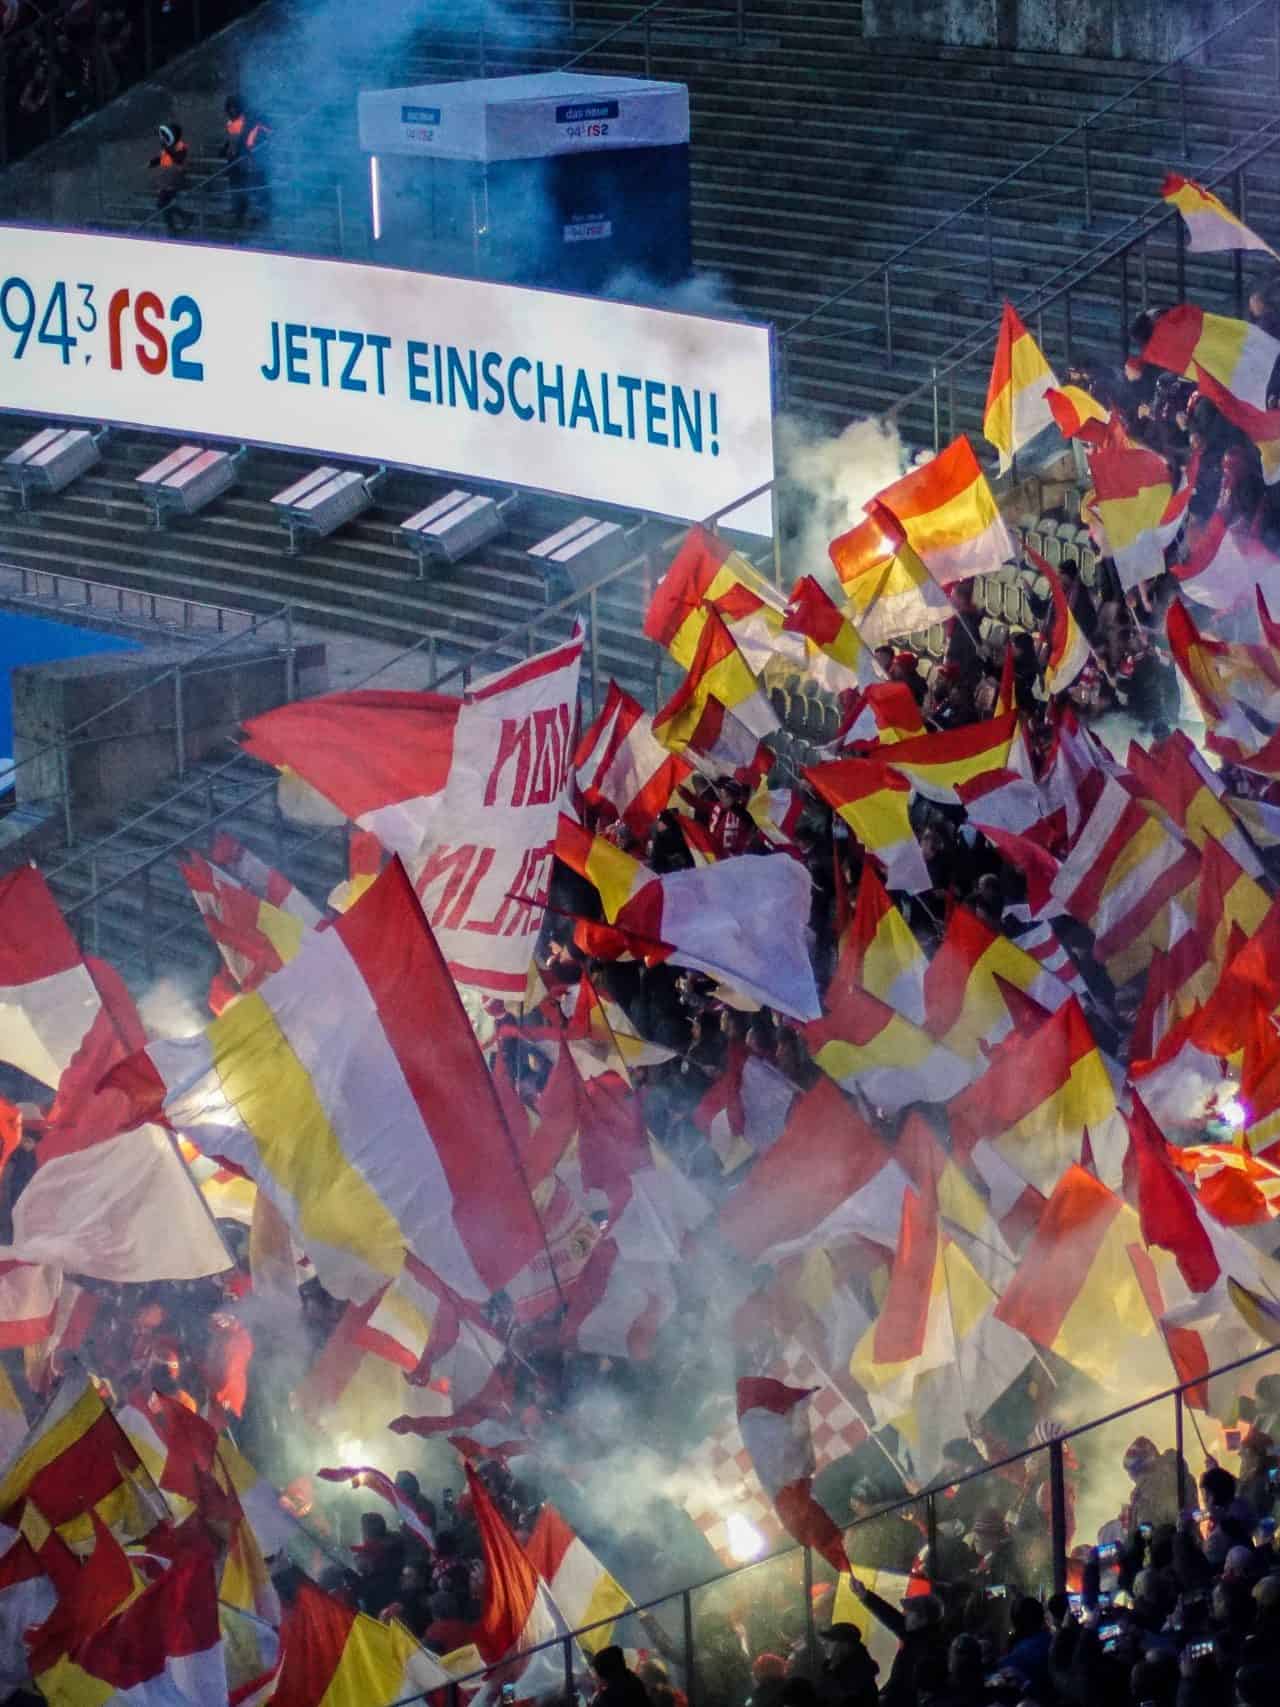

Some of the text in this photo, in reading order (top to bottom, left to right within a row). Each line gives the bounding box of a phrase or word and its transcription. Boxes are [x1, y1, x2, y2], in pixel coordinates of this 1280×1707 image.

[107, 288, 204, 381] rs2
[260, 321, 391, 395] JETZT
[407, 340, 719, 456] EINSCHALTEN!
